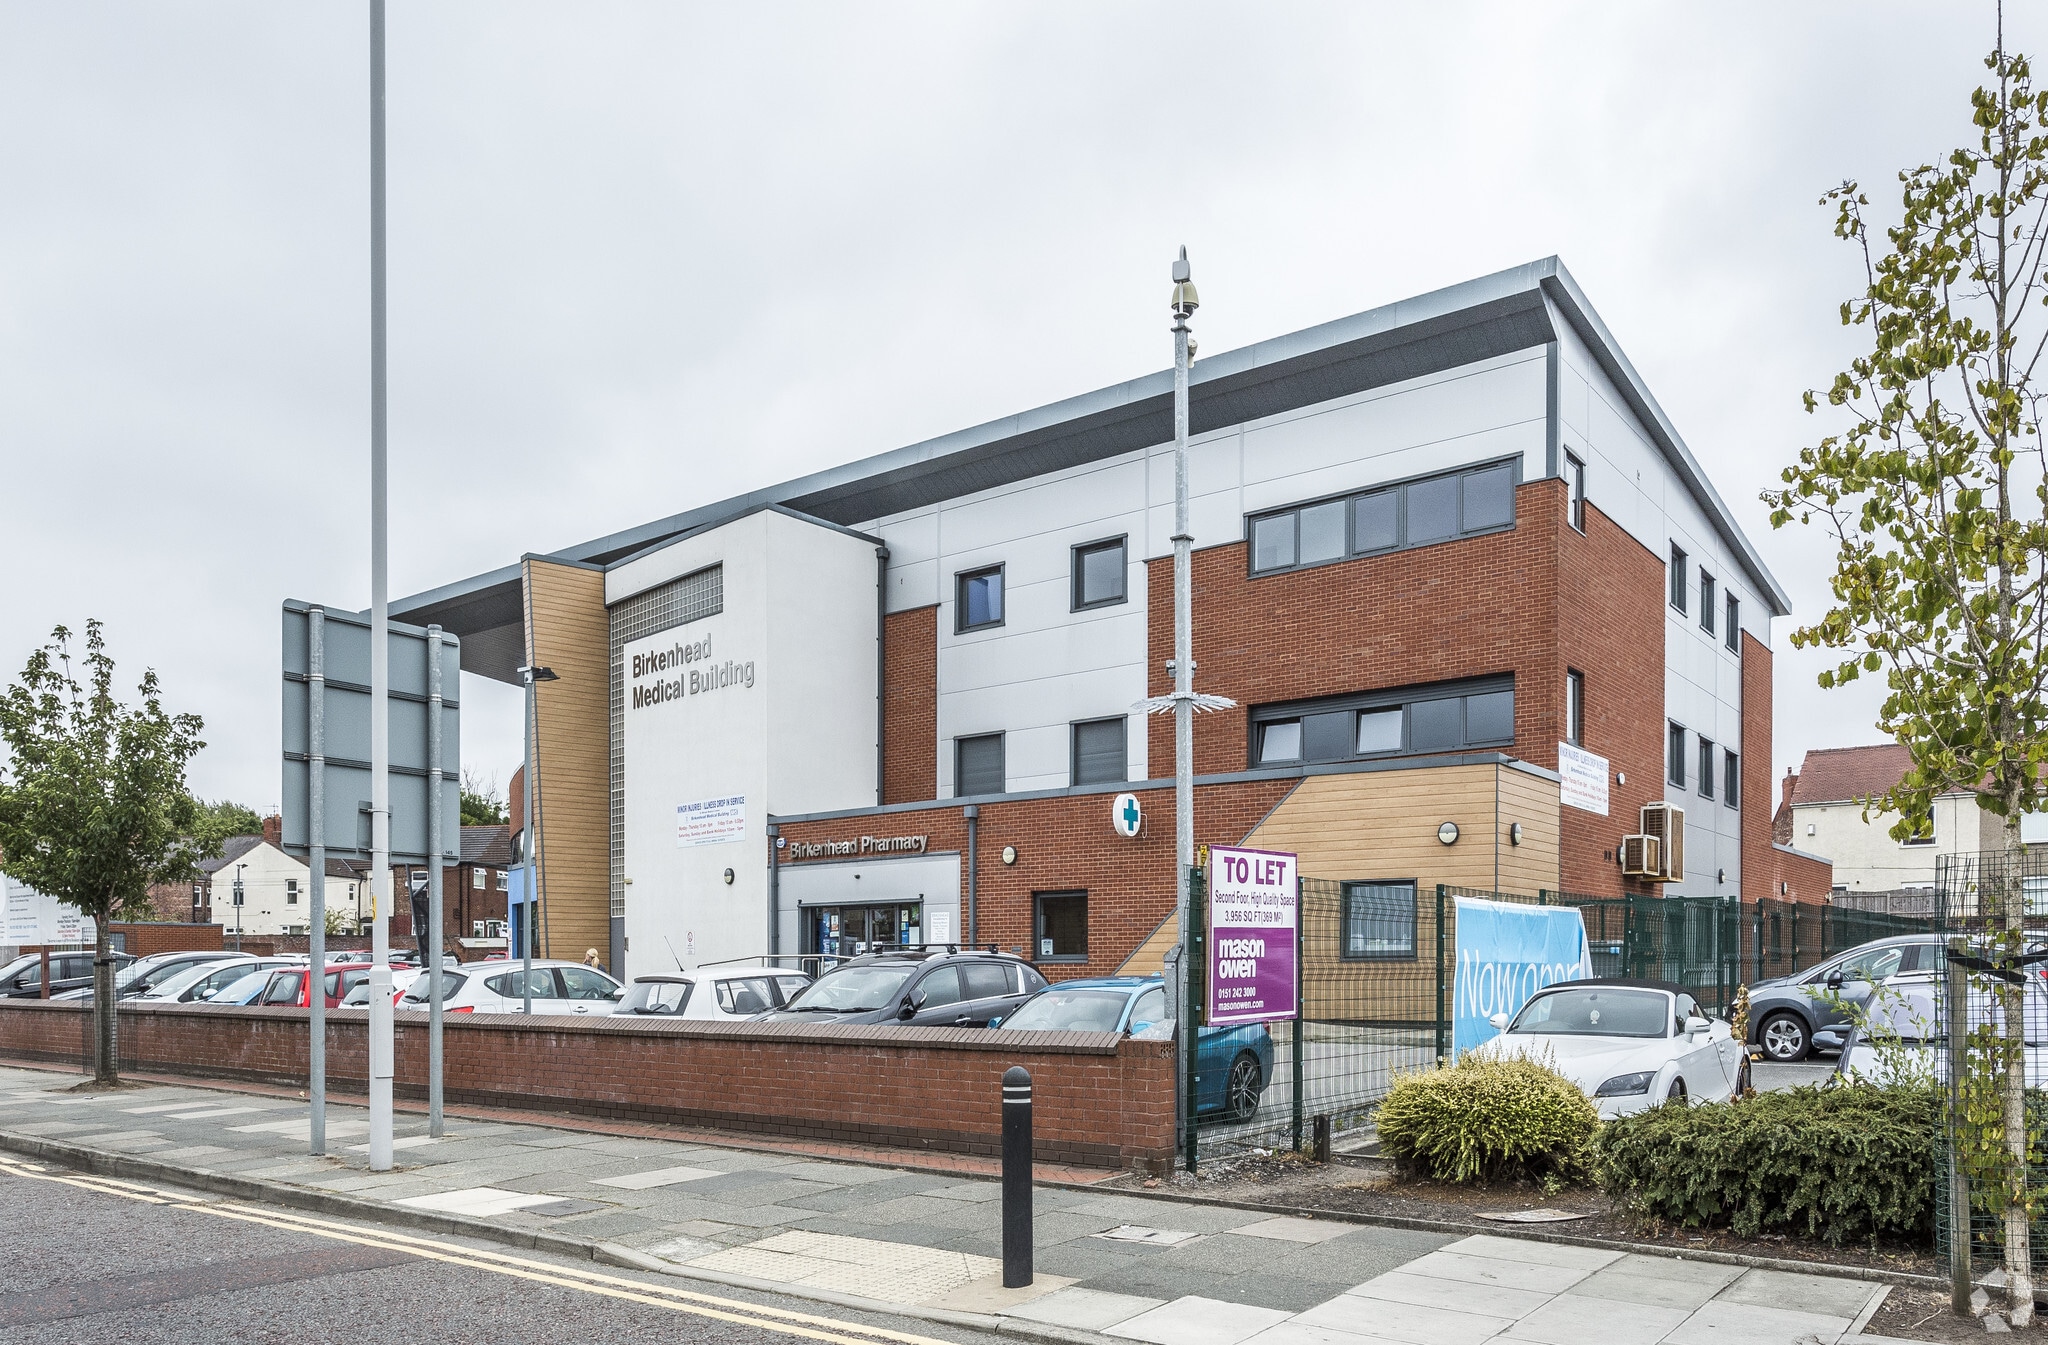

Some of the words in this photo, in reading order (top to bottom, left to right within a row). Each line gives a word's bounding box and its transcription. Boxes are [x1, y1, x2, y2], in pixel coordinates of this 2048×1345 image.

[633, 633, 711, 678] Birkenhead
[633, 673, 684, 710] Medical
[690, 660, 754, 695] Building
[790, 838, 858, 858] Birkenhead
[861, 835, 928, 853] Pharmacy
[1224, 856, 1249, 884] TO
[1255, 859, 1287, 886] LET
[1215, 889, 1236, 904] Second
[1250, 891, 1262, 908] High
[1262, 892, 1280, 909] Quality
[1280, 893, 1295, 908] Space
[1224, 910, 1242, 923] 3,956
[1243, 911, 1253, 923] SQ
[1218, 938, 1266, 959] mason
[1218, 958, 1257, 979] owen
[1217, 988, 1231, 999] 0151
[1231, 987, 1243, 998] 242
[1243, 986, 1256, 997] 3000
[1460, 948, 1520, 1019] Now
[1217, 1000, 1265, 1012] masonowen.com
